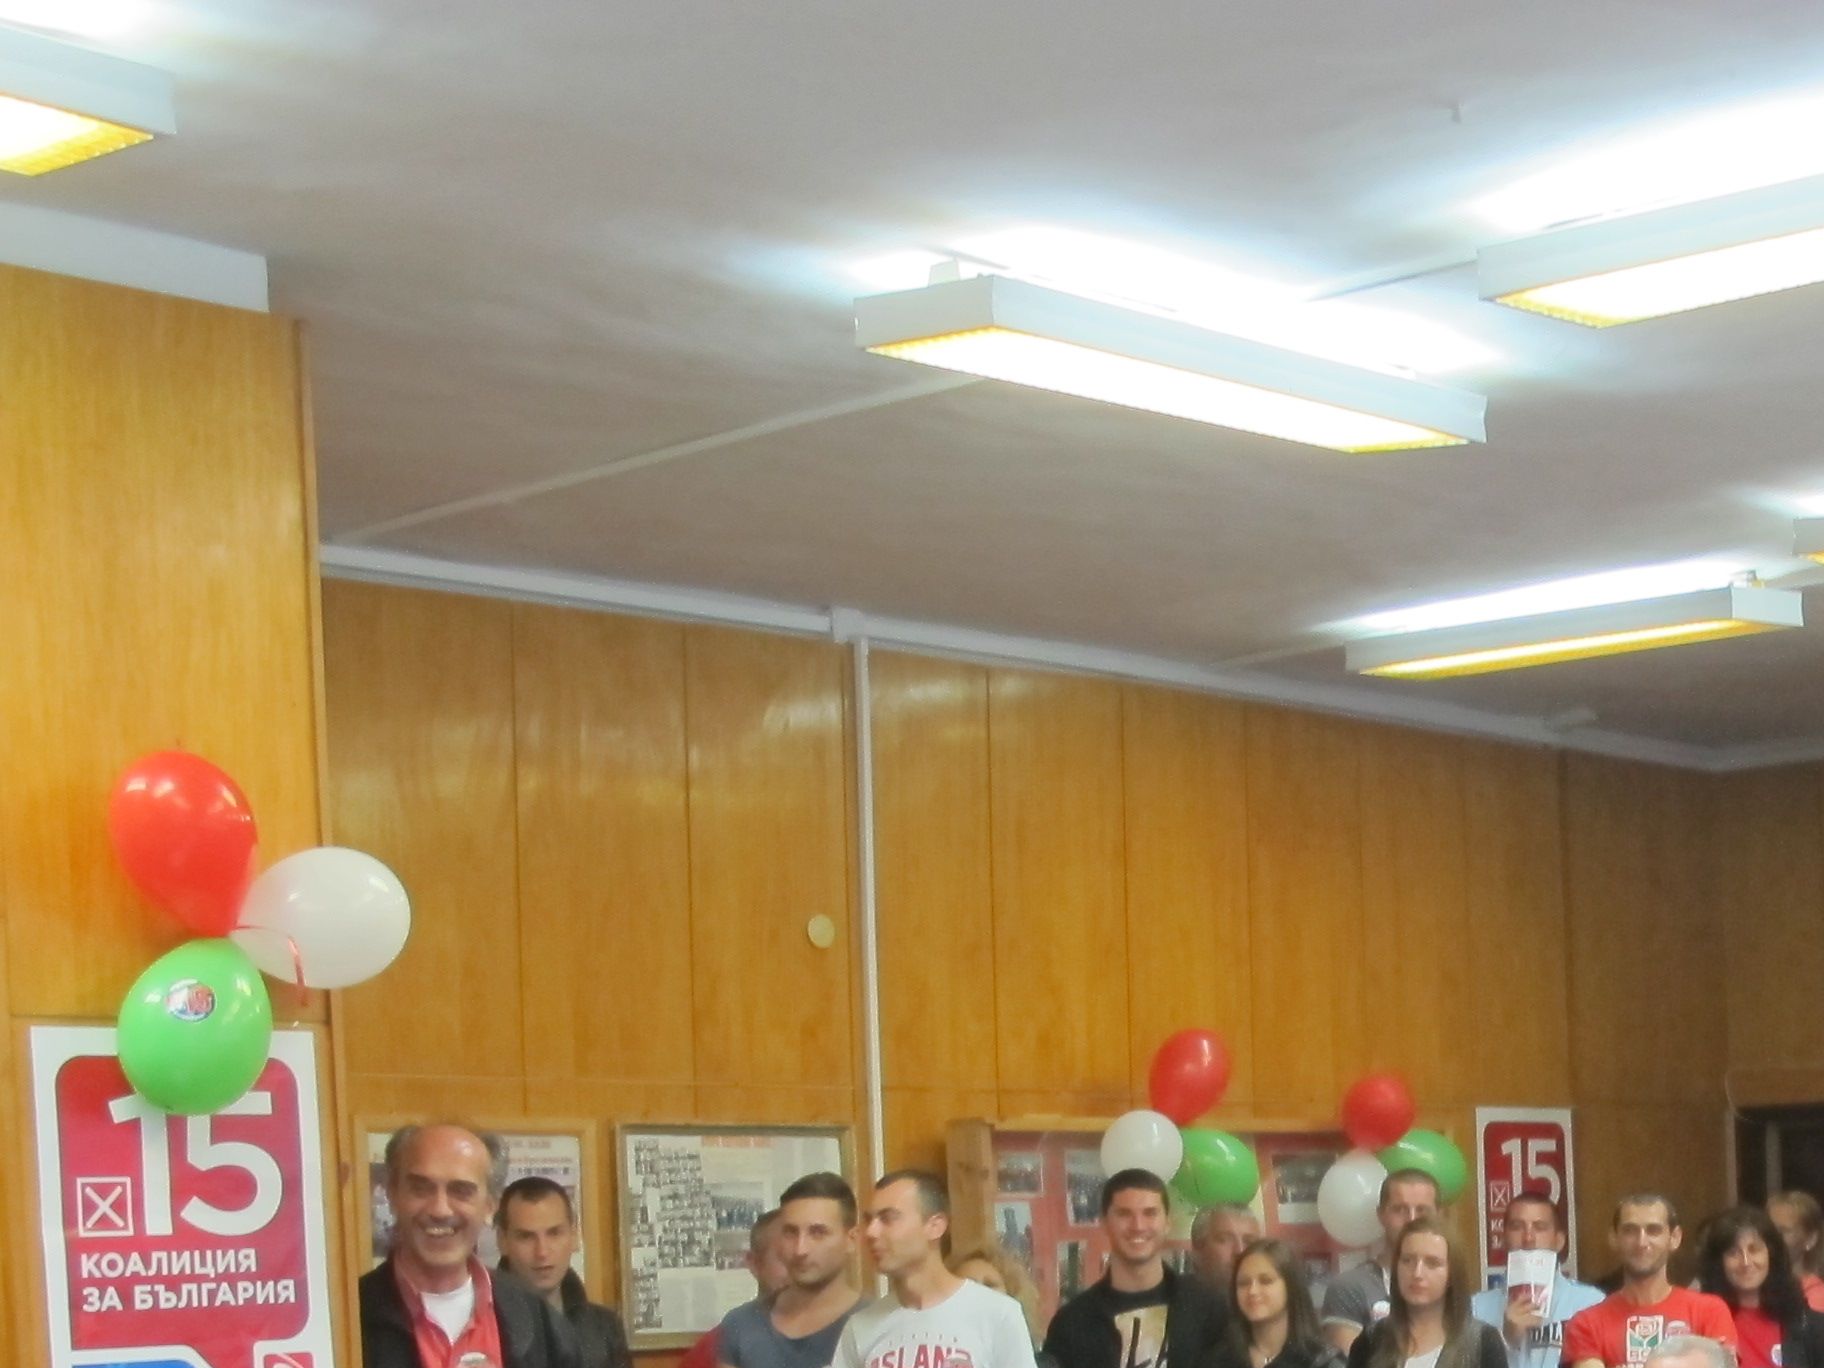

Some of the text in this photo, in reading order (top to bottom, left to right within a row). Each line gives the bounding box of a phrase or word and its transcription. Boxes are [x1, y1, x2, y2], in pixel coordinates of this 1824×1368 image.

[108, 1091, 283, 1237] 15
[1501, 1138, 1560, 1204] 15
[81, 1248, 257, 1279] КОАЛИЦИЯ
[82, 1279, 296, 1312] ЗА БЪЛГАРИЯ
